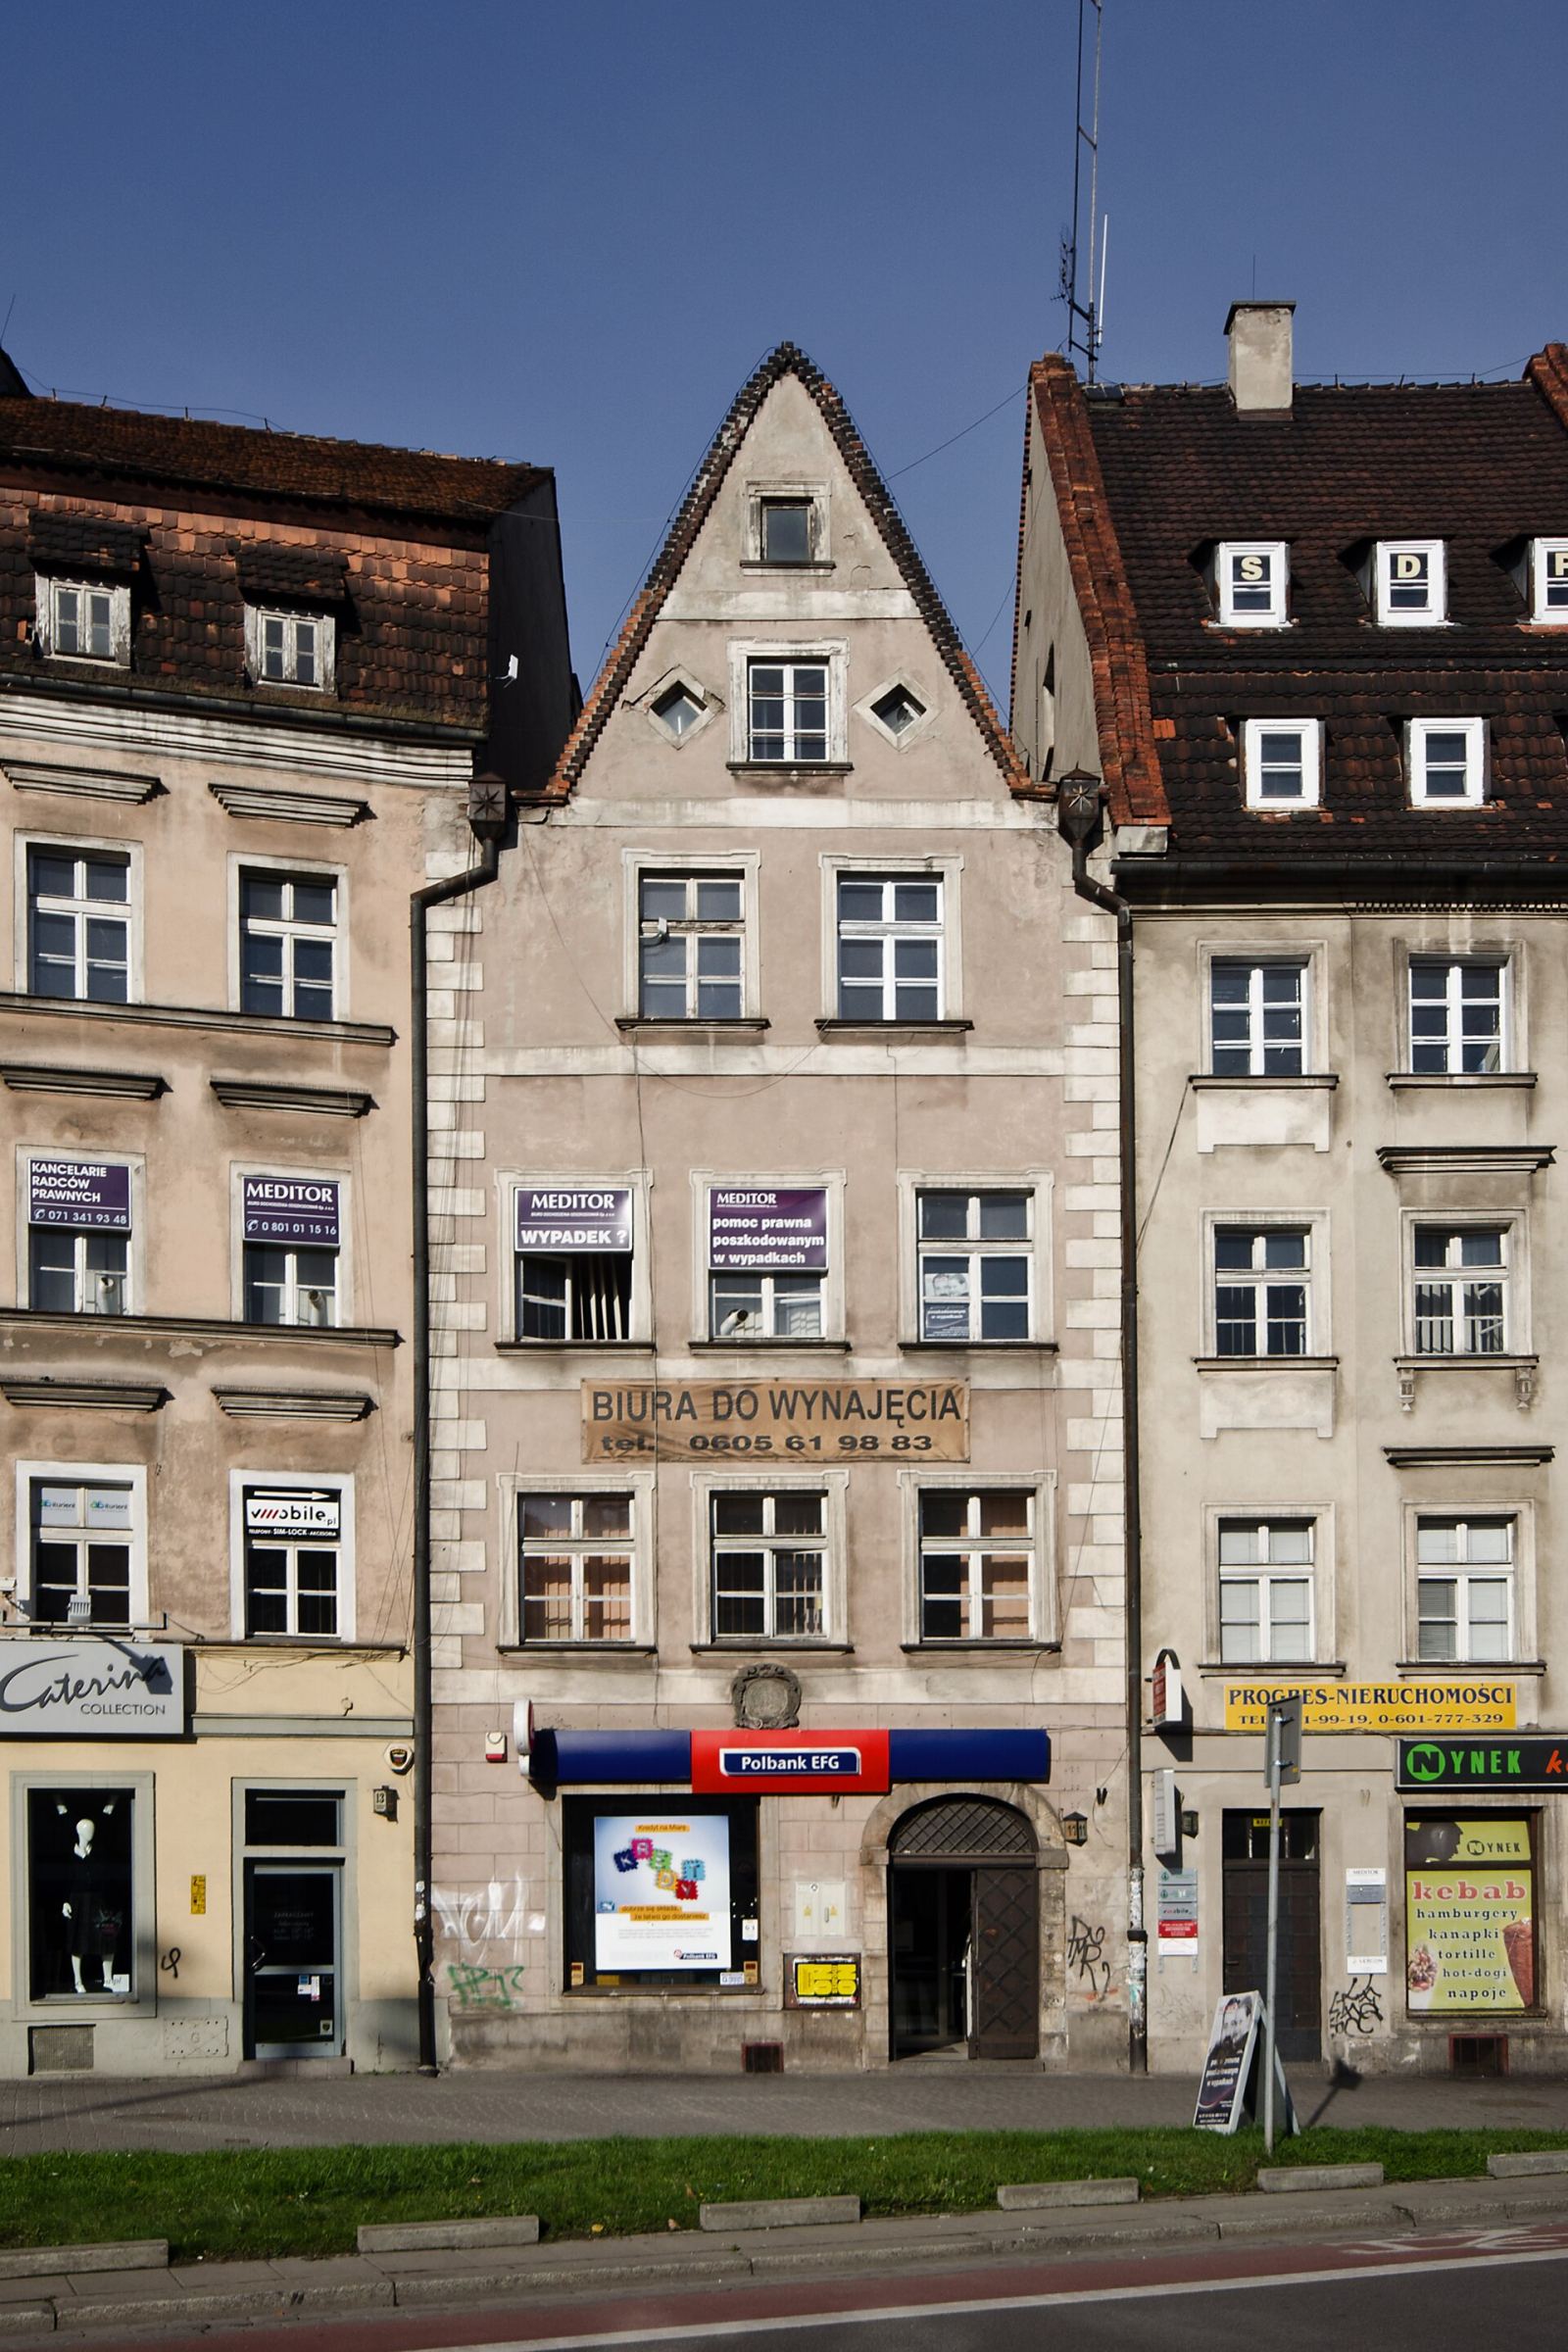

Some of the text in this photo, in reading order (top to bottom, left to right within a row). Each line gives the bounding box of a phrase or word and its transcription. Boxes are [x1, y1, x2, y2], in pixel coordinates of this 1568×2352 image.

[1241, 556, 1263, 581] S
[1396, 554, 1421, 578] D
[31, 1161, 108, 1178] KANCELARIE
[31, 1175, 90, 1190] RADCÓW
[31, 1188, 101, 1203] PRAWNYCH
[246, 1182, 333, 1203] MEDITOR
[716, 1193, 777, 1204] MEDITOR
[531, 1194, 615, 1209] MEDITOR
[48, 1210, 126, 1225] 071 341 93 48
[712, 1217, 812, 1231] pomoc prawna
[262, 1221, 337, 1235] 0 801 01 15 16
[520, 1229, 612, 1245] WYPADEK
[712, 1234, 825, 1249] poszkodowanym
[713, 1251, 806, 1266] w wypadkach
[592, 1389, 961, 1429] BIURA DO WYNAJĘCIA
[601, 1434, 933, 1452] tel. 0605 61 98 83
[272, 1528, 308, 1537] SIM-LOCK
[0, 1653, 166, 1713] Caterina
[79, 1703, 166, 1715] COLLECTION
[1378, 1713, 1504, 1725] 0-601-777-329
[741, 1755, 840, 1771] Polbank EFG
[375, 1792, 385, 1804] 13
[1412, 1881, 1527, 1901] kebab
[1416, 1908, 1518, 1921] hamburgery
[1428, 1928, 1499, 1942] kanapki
[1438, 1948, 1495, 1960] tortille
[1443, 1967, 1507, 1981] hot-dogi
[1447, 1986, 1507, 2001] napoje
